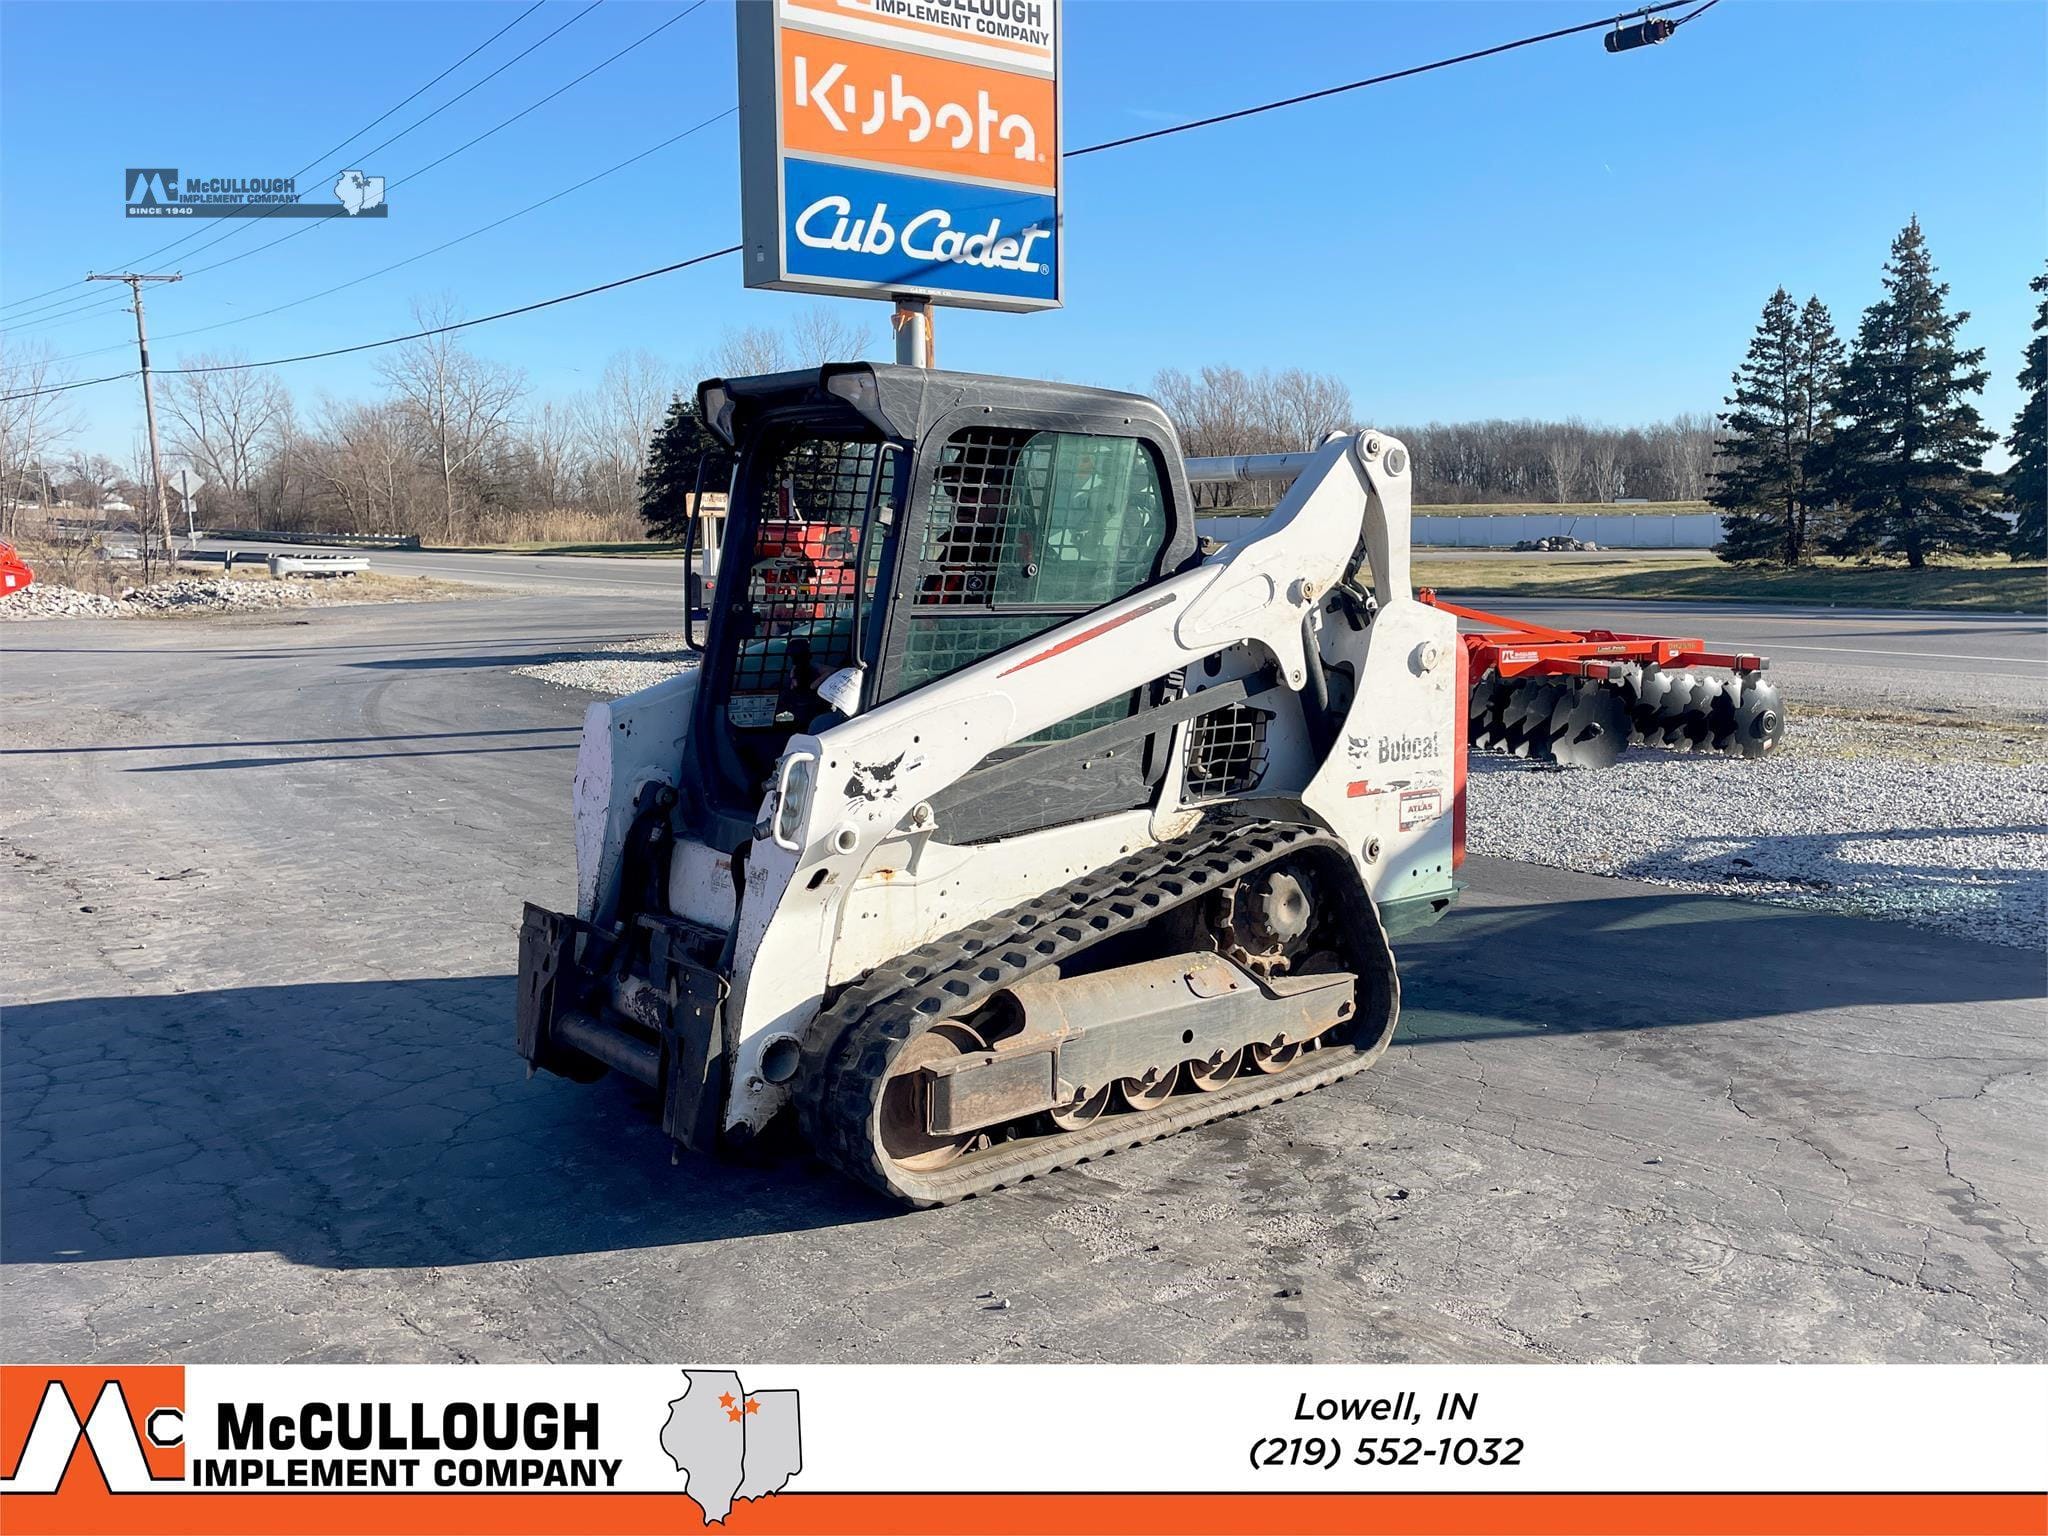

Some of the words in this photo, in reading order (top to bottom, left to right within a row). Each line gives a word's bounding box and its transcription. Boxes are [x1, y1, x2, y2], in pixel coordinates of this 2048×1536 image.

[875, 0, 971, 30] IMPLEMENT
[976, 18, 1050, 46] COMPANY
[793, 55, 1037, 162] Kubota
[795, 195, 896, 255] Cub
[900, 209, 1051, 274] Cadet
[1407, 803, 1433, 813] ATLAS
